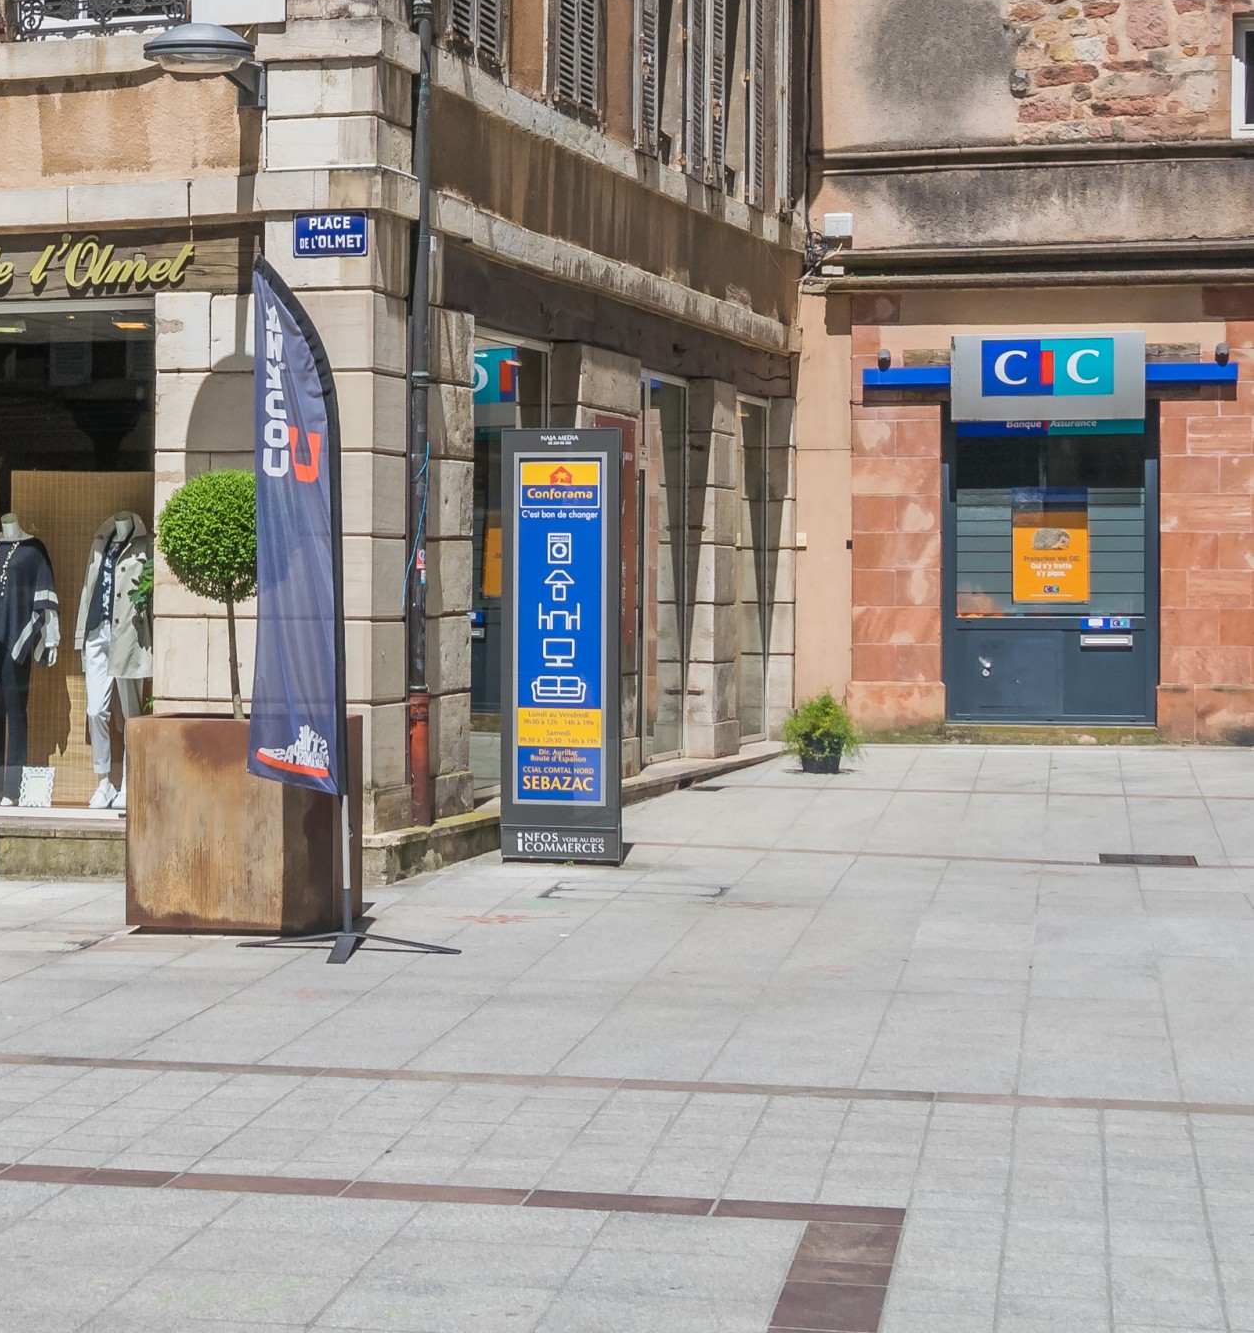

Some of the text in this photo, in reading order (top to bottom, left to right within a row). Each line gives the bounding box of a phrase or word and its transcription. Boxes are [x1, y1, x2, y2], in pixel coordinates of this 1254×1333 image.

[308, 216, 351, 230] PLACE
[299, 234, 363, 249] DE L'OLMET
[30, 233, 194, 289] l'Olmet
[994, 349, 1100, 385] CIC
[1006, 421, 1042, 430] Banque
[527, 488, 593, 499] Conforama
[522, 510, 598, 520] C'est bon de changer
[551, 755, 587, 763] d'Espalion
[543, 766, 572, 774] COMTAL
[574, 767, 594, 775] NORD
[522, 775, 594, 791] SEBAZAC
[524, 842, 605, 853] COMMERCES
